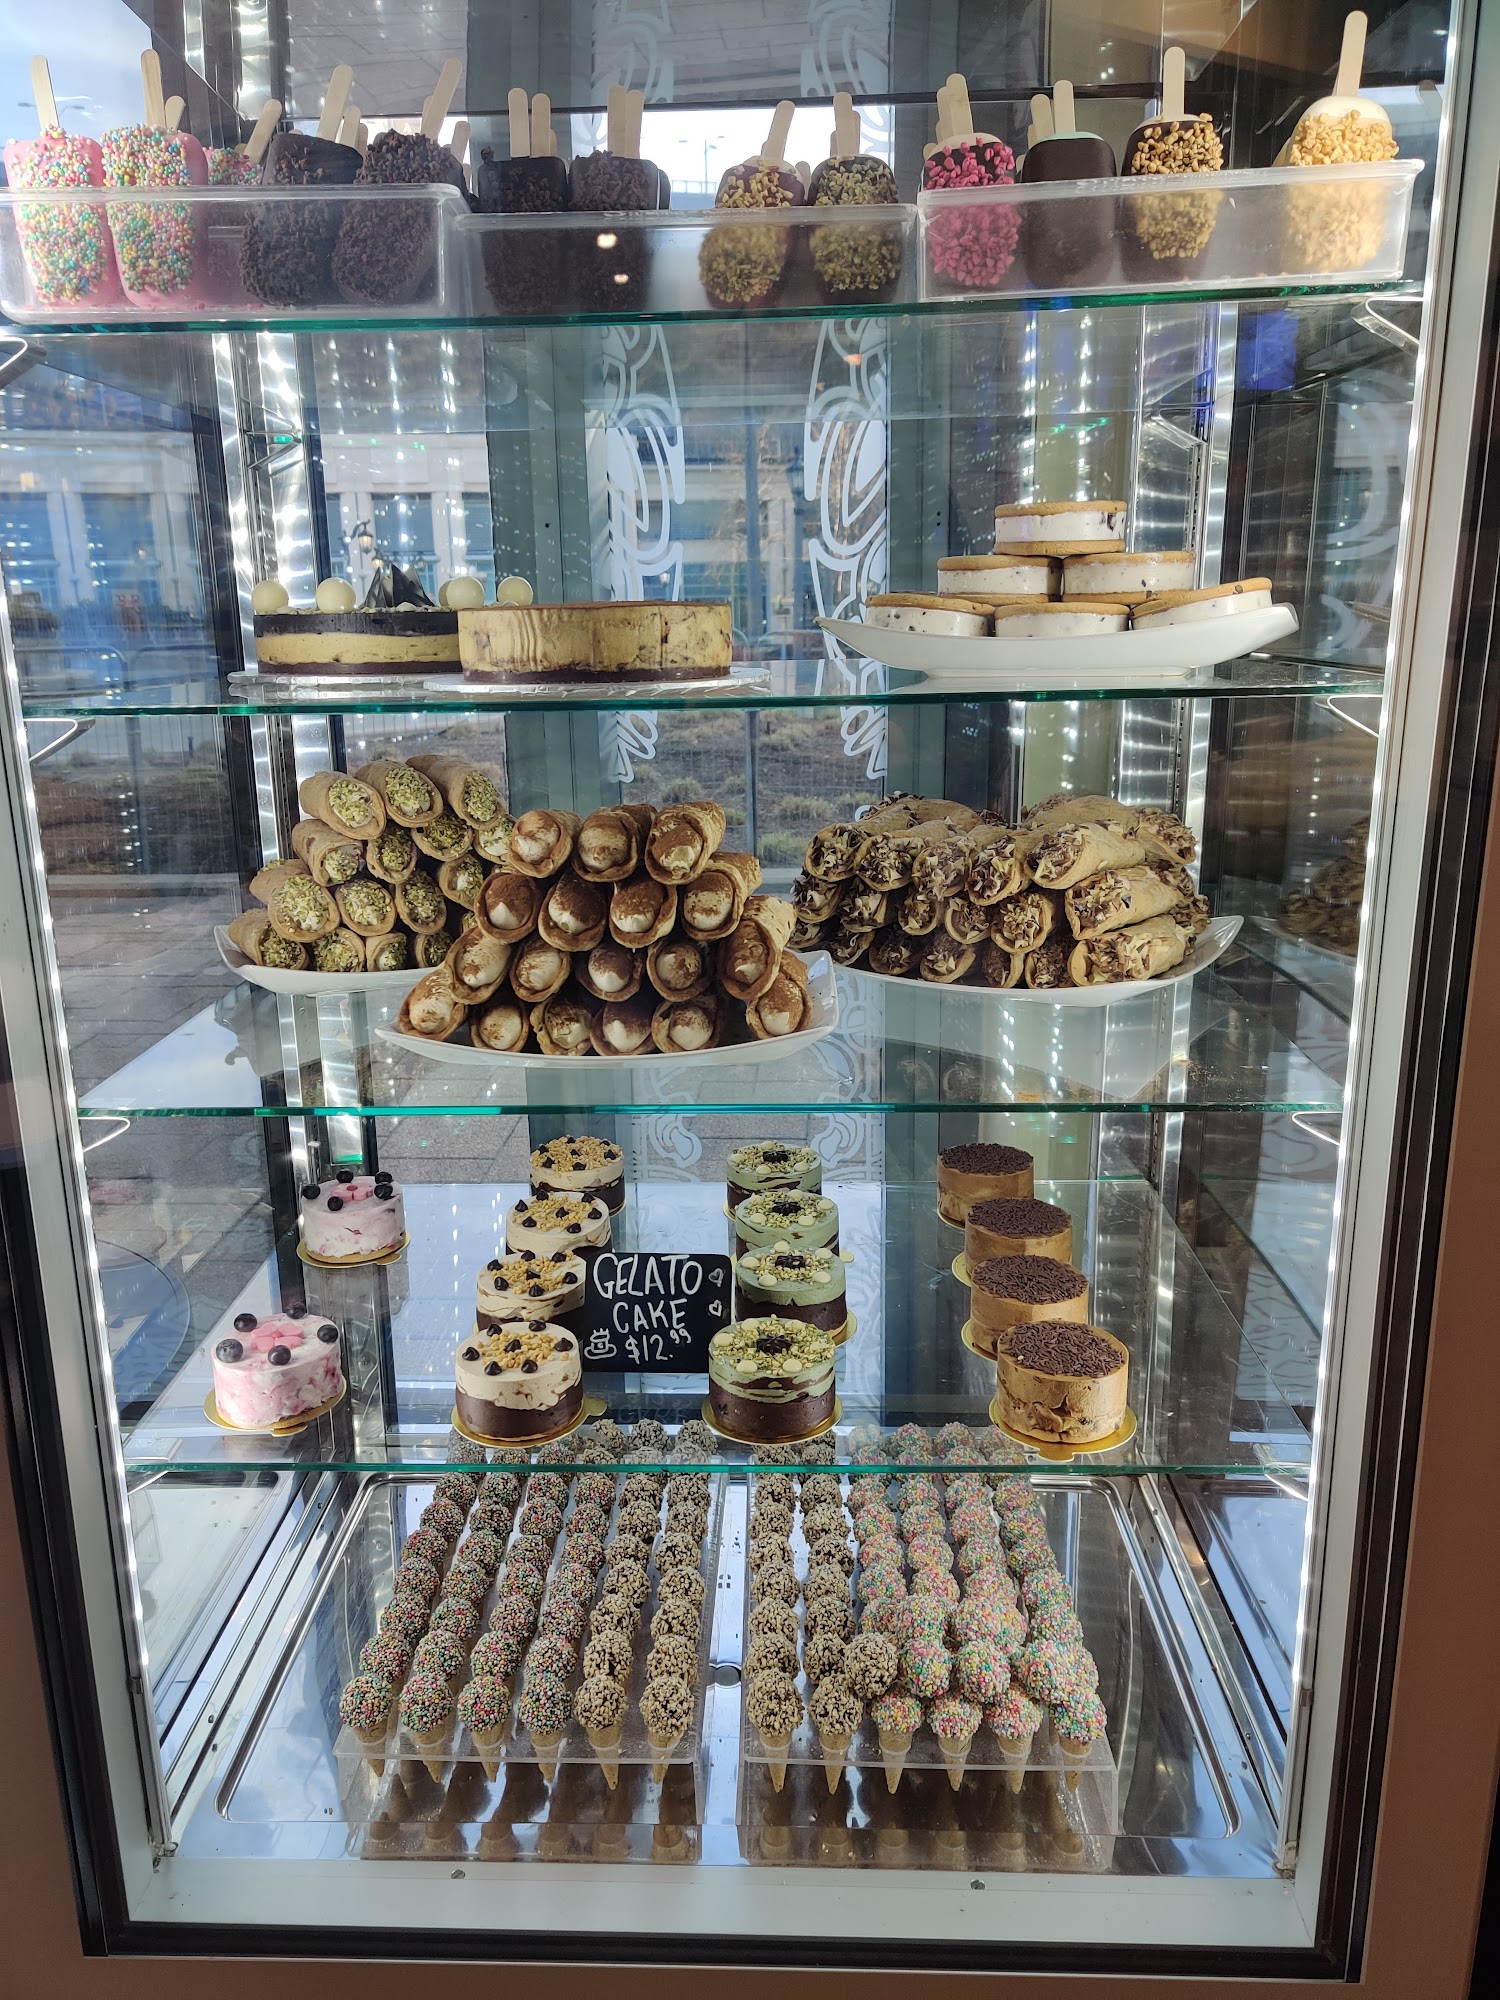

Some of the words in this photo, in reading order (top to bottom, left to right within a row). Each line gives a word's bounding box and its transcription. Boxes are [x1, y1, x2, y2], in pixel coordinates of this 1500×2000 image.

[593, 1253, 703, 1299] GELATO
[612, 1298, 688, 1334] CAKE
[624, 1328, 692, 1364] $12.99
